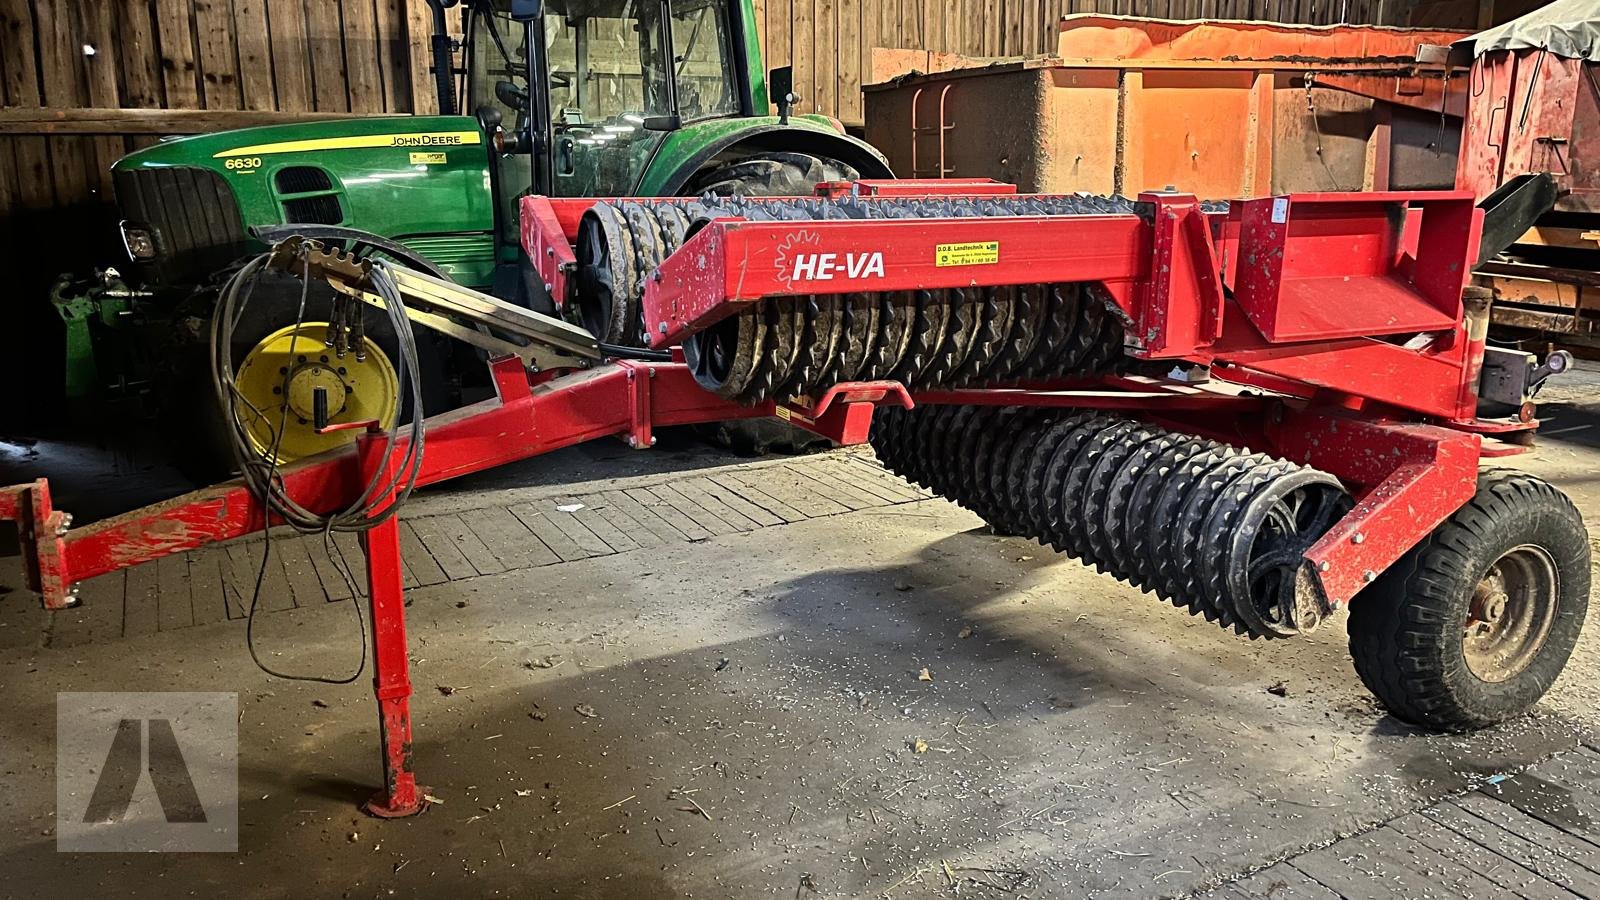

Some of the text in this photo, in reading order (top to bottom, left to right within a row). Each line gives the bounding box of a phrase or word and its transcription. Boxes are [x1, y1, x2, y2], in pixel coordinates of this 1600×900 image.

[391, 135, 461, 146] JOHN DEERE
[225, 157, 262, 170] 6630
[792, 252, 885, 281] HE-VA
